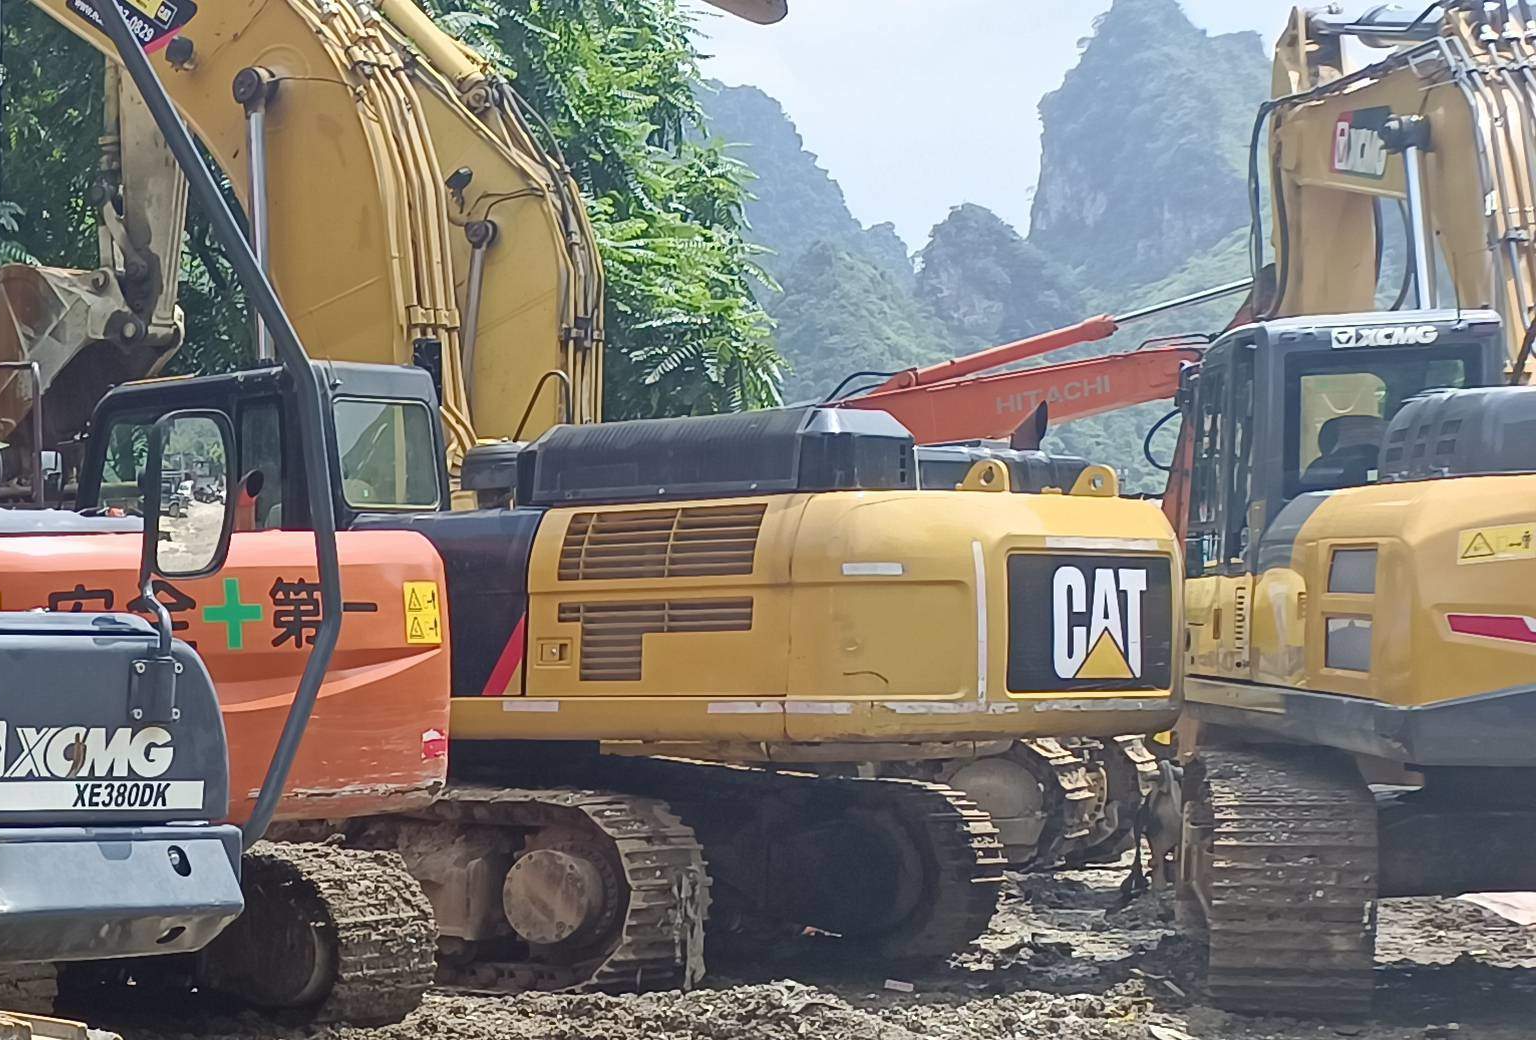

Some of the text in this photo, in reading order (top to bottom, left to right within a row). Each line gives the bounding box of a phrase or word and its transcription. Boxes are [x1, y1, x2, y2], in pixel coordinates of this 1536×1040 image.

[1355, 325, 1439, 347] XCMG
[995, 374, 1112, 415] HITACHI
[1053, 565, 1148, 680] CAT
[3, 725, 175, 779] XCMG
[71, 782, 171, 808] XE380DK
